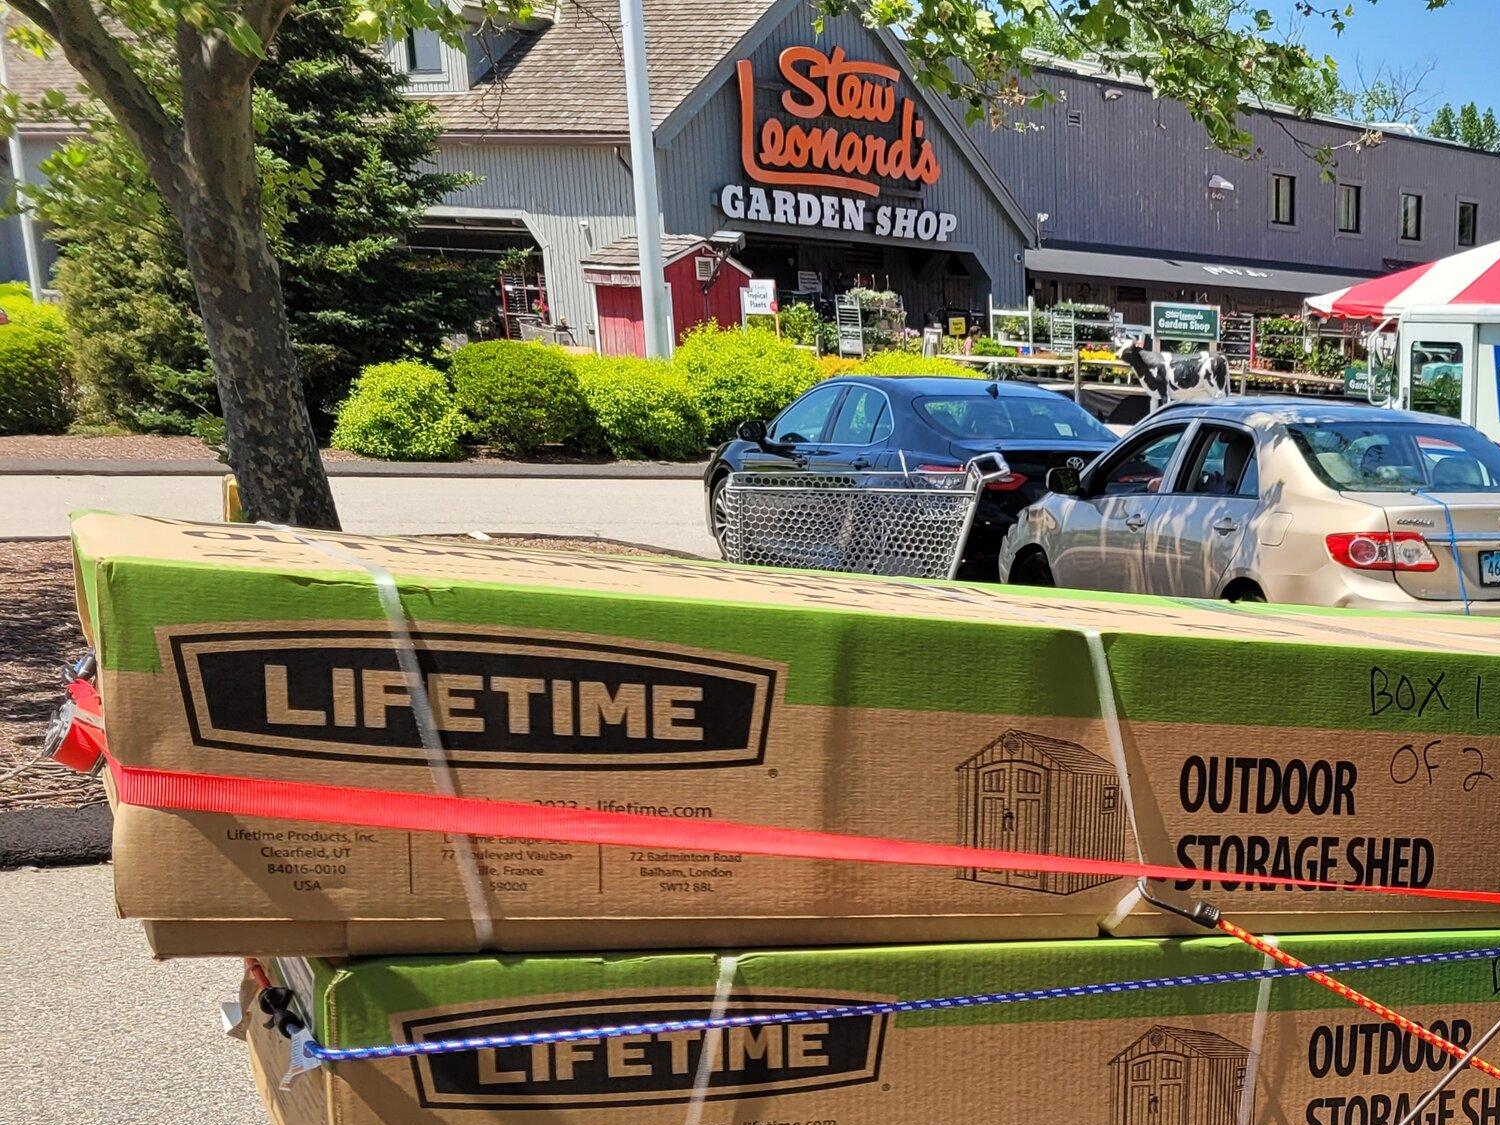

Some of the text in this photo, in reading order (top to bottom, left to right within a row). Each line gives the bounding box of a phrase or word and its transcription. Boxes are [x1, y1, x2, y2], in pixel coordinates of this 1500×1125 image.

[779, 46, 900, 122] Stew
[736, 59, 941, 198] Leonard's
[721, 184, 957, 242] GARDEN SHOP
[1158, 318, 1188, 330] Garden
[1189, 319, 1210, 333] Shop
[264, 664, 704, 742] LIFETIME
[1370, 666, 1482, 719] BOX 1
[1390, 740, 1494, 792] OF 2
[1180, 755, 1358, 816] OUTDOOR
[226, 829, 379, 844] Lifetime Products, Inc.
[260, 846, 351, 859] Clearfield, UT
[267, 864, 347, 875] 84016-0010
[441, 849, 573, 861] 77 oulevard Vauban
[503, 866, 546, 877] France
[630, 852, 743, 863] 72 Badminton Road
[1174, 833, 1435, 892] STORAGE SHED
[293, 880, 322, 891] USA
[640, 867, 733, 878] Balham, London
[659, 882, 690, 893] SW12
[477, 1022, 830, 1085] LIFETIME
[1308, 1019, 1472, 1079] OUTDOOR
